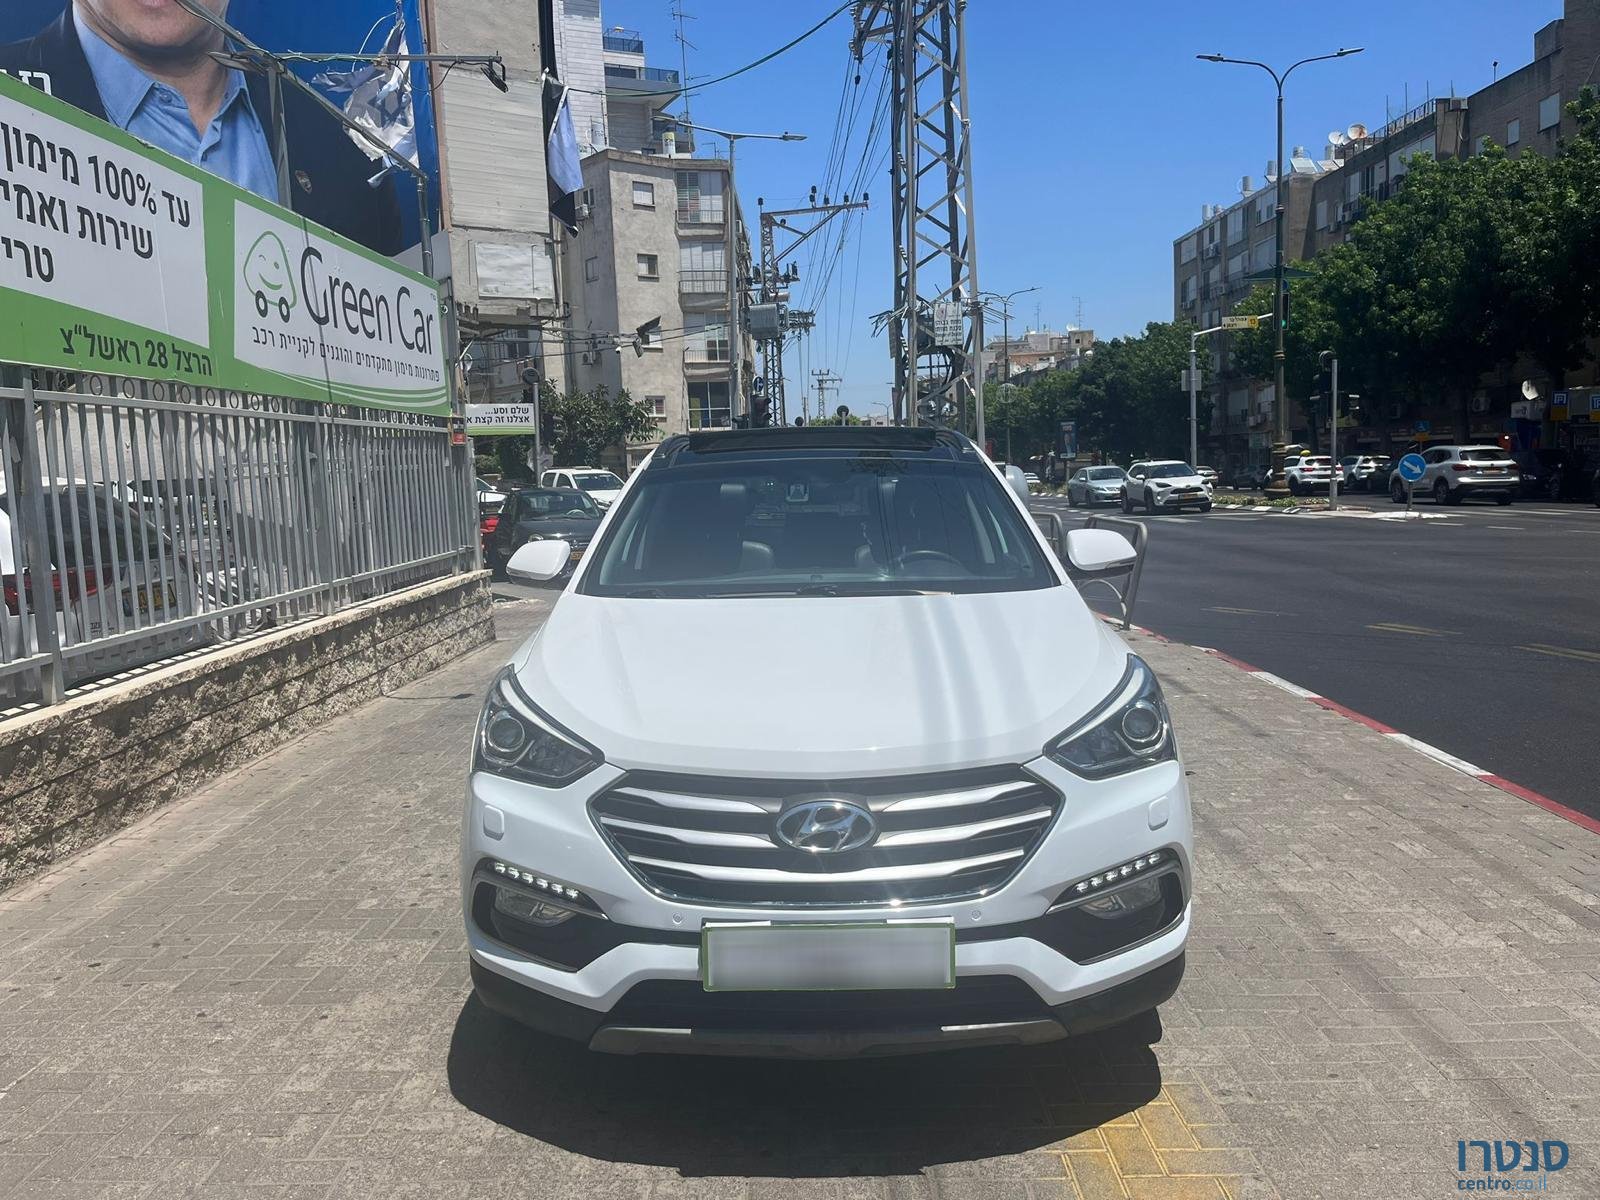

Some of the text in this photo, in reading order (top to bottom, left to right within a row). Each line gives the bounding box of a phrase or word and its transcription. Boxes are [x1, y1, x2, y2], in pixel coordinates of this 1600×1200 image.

[0, 121, 191, 228] עד 100% מימון
[77, 205, 153, 260] שירות
[1, 235, 55, 283] טרי
[300, 246, 434, 356] Green Car
[144, 339, 169, 369] 28
[171, 342, 213, 377] הרצל
[252, 326, 440, 382] פתרונות מימון מתקדמים והוגנים לקניית רכב
[475, 416, 493, 425] קצת
[507, 414, 530, 423] אצלנו
[511, 406, 529, 415] שלם
